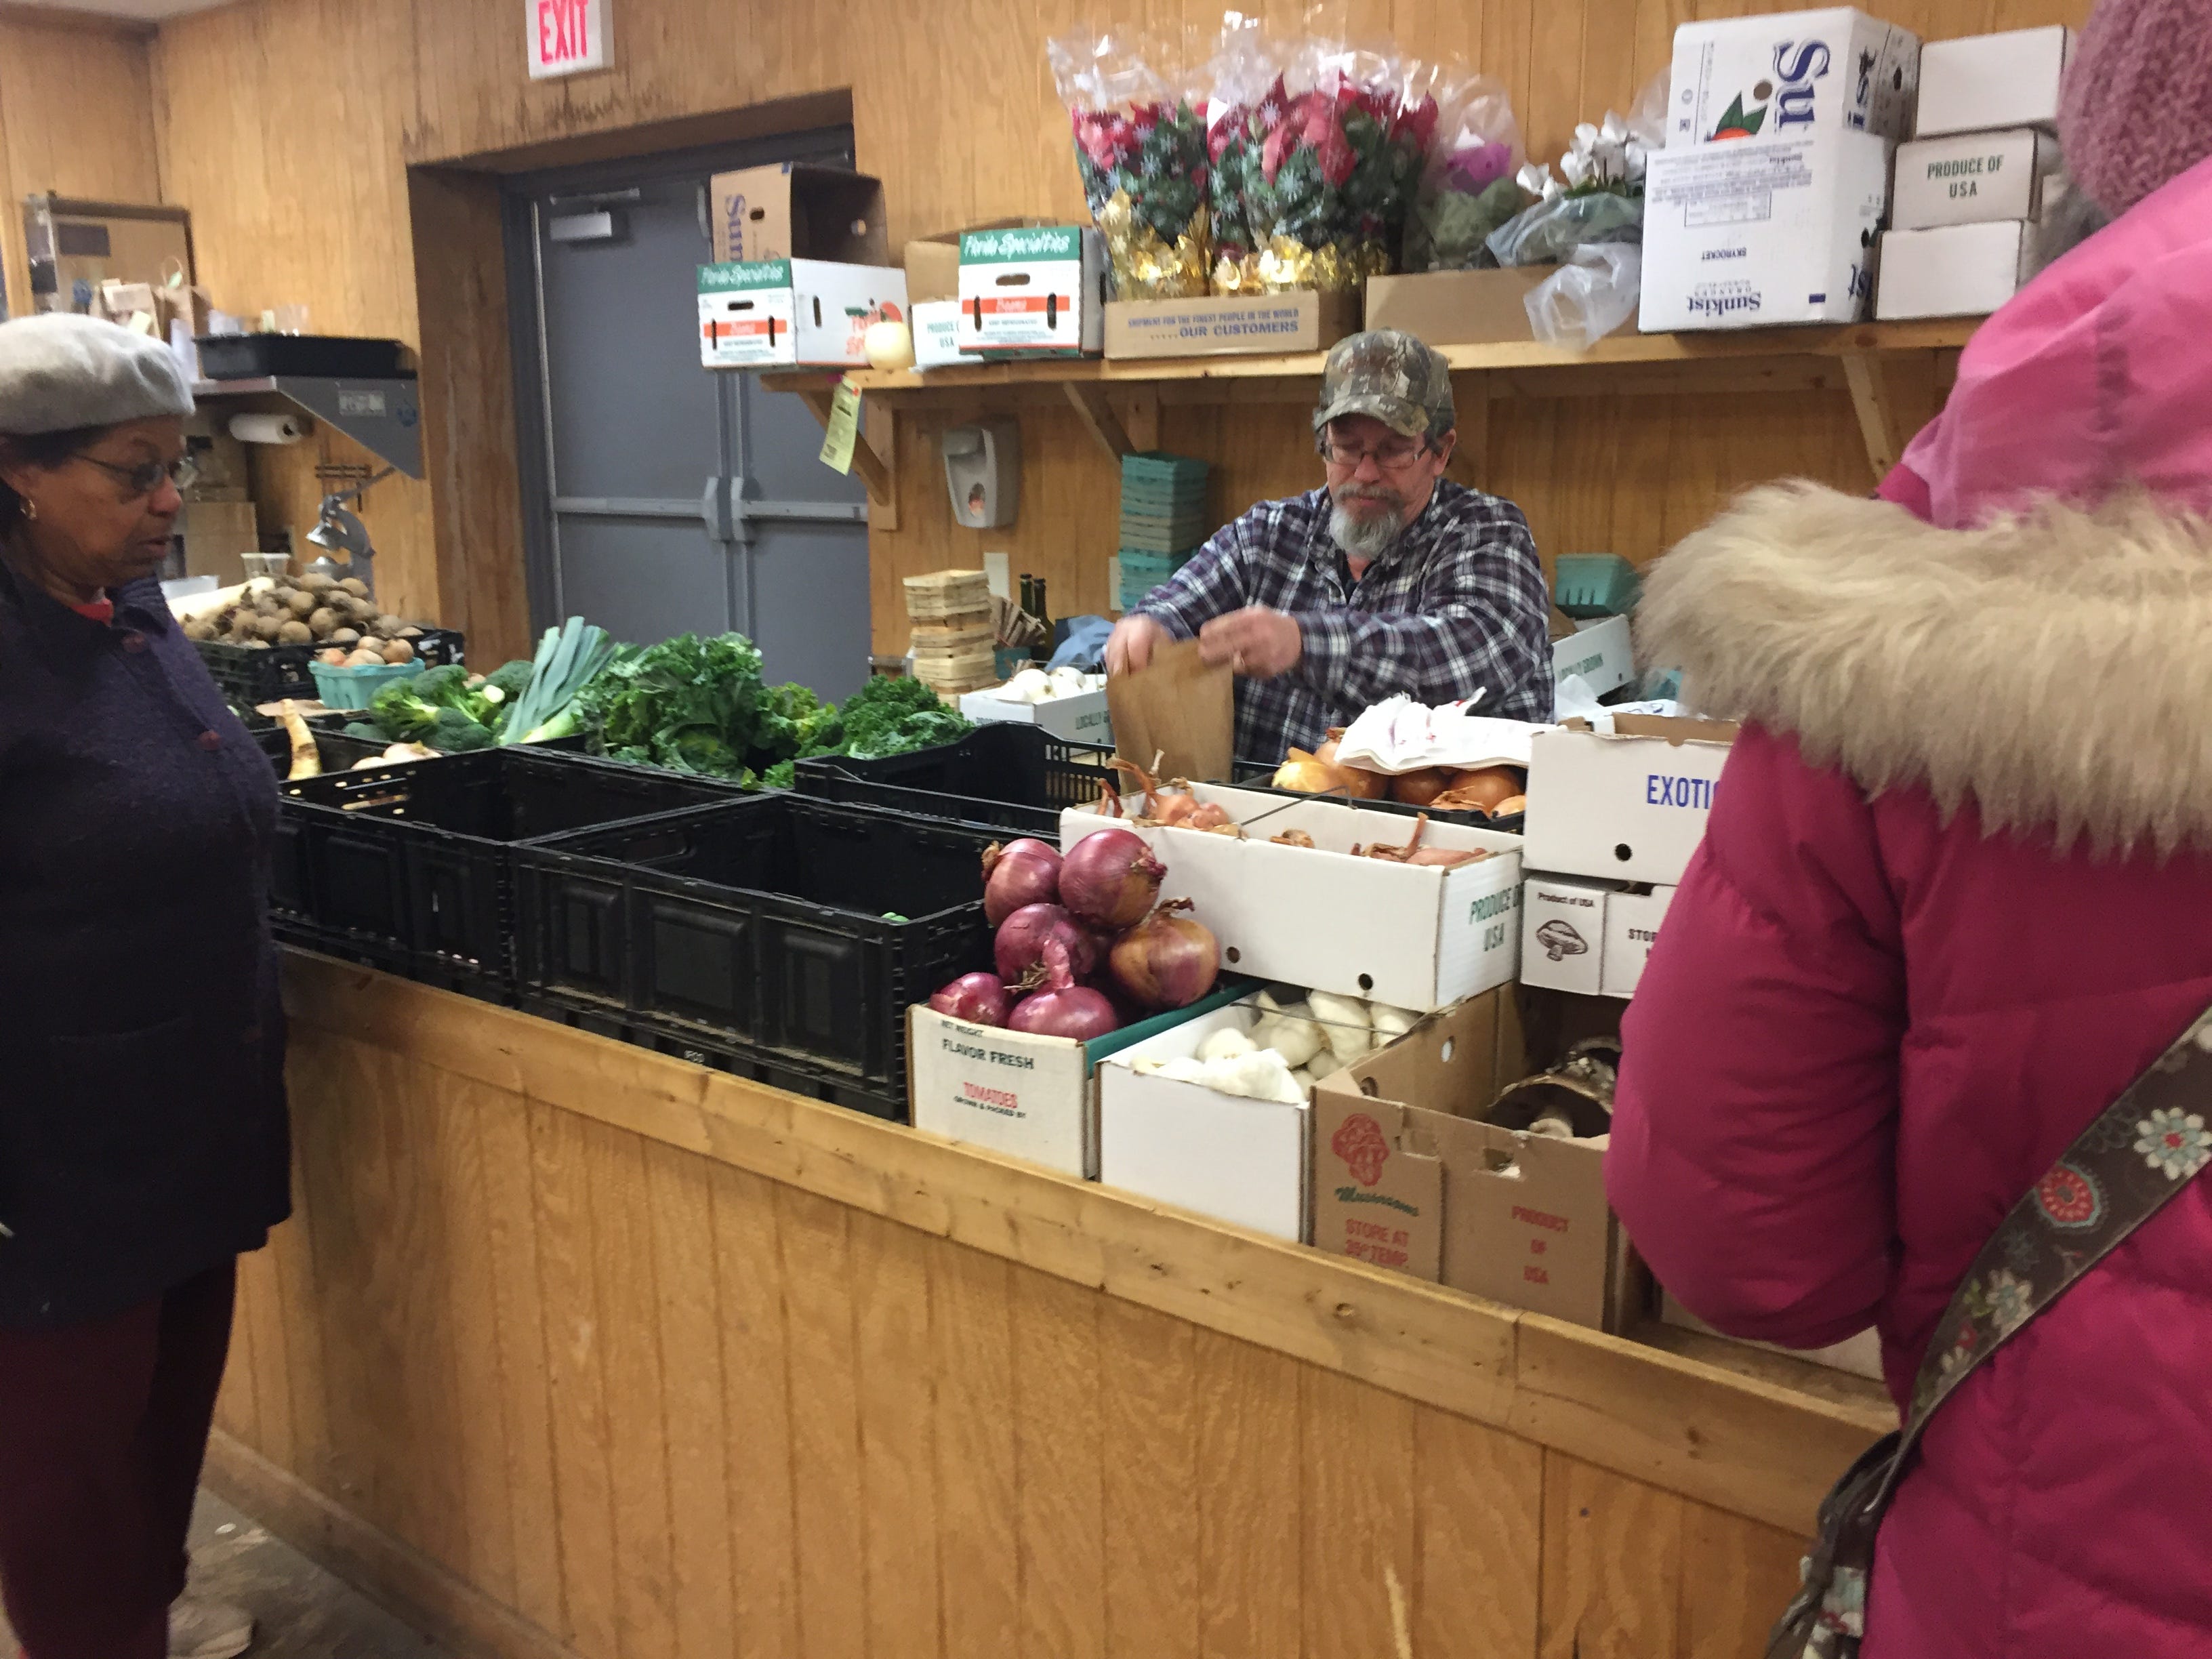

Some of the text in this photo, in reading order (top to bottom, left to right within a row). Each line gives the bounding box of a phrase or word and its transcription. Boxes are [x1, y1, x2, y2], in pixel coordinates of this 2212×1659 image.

[538, 0, 588, 64] EXIT
[1772, 39, 1831, 134] Su
[1927, 155, 2005, 180] PRODUCE OF
[1949, 180, 1978, 198] USA
[1177, 315, 1190, 325] THE
[1218, 311, 1246, 322] PEOPLE
[1258, 309, 1271, 319] THE
[1273, 307, 1300, 319] WORLD
[1687, 291, 1761, 317] Sunkist
[1212, 320, 1300, 337] CUSTOMERS
[939, 336, 955, 348] USA
[1647, 774, 1719, 809] EXOTI
[1469, 888, 1512, 924] PRODUCE
[1537, 892, 1568, 903] Product
[1580, 898, 1595, 907] USA
[1483, 922, 1504, 951] USA
[942, 1038, 1035, 1069] FLAVOR FRESH
[964, 1082, 1018, 1109] TOMATOES
[1345, 1218, 1410, 1248] STORE AT
[1530, 1239, 1547, 1255] OF
[1523, 1265, 1549, 1284] USA
